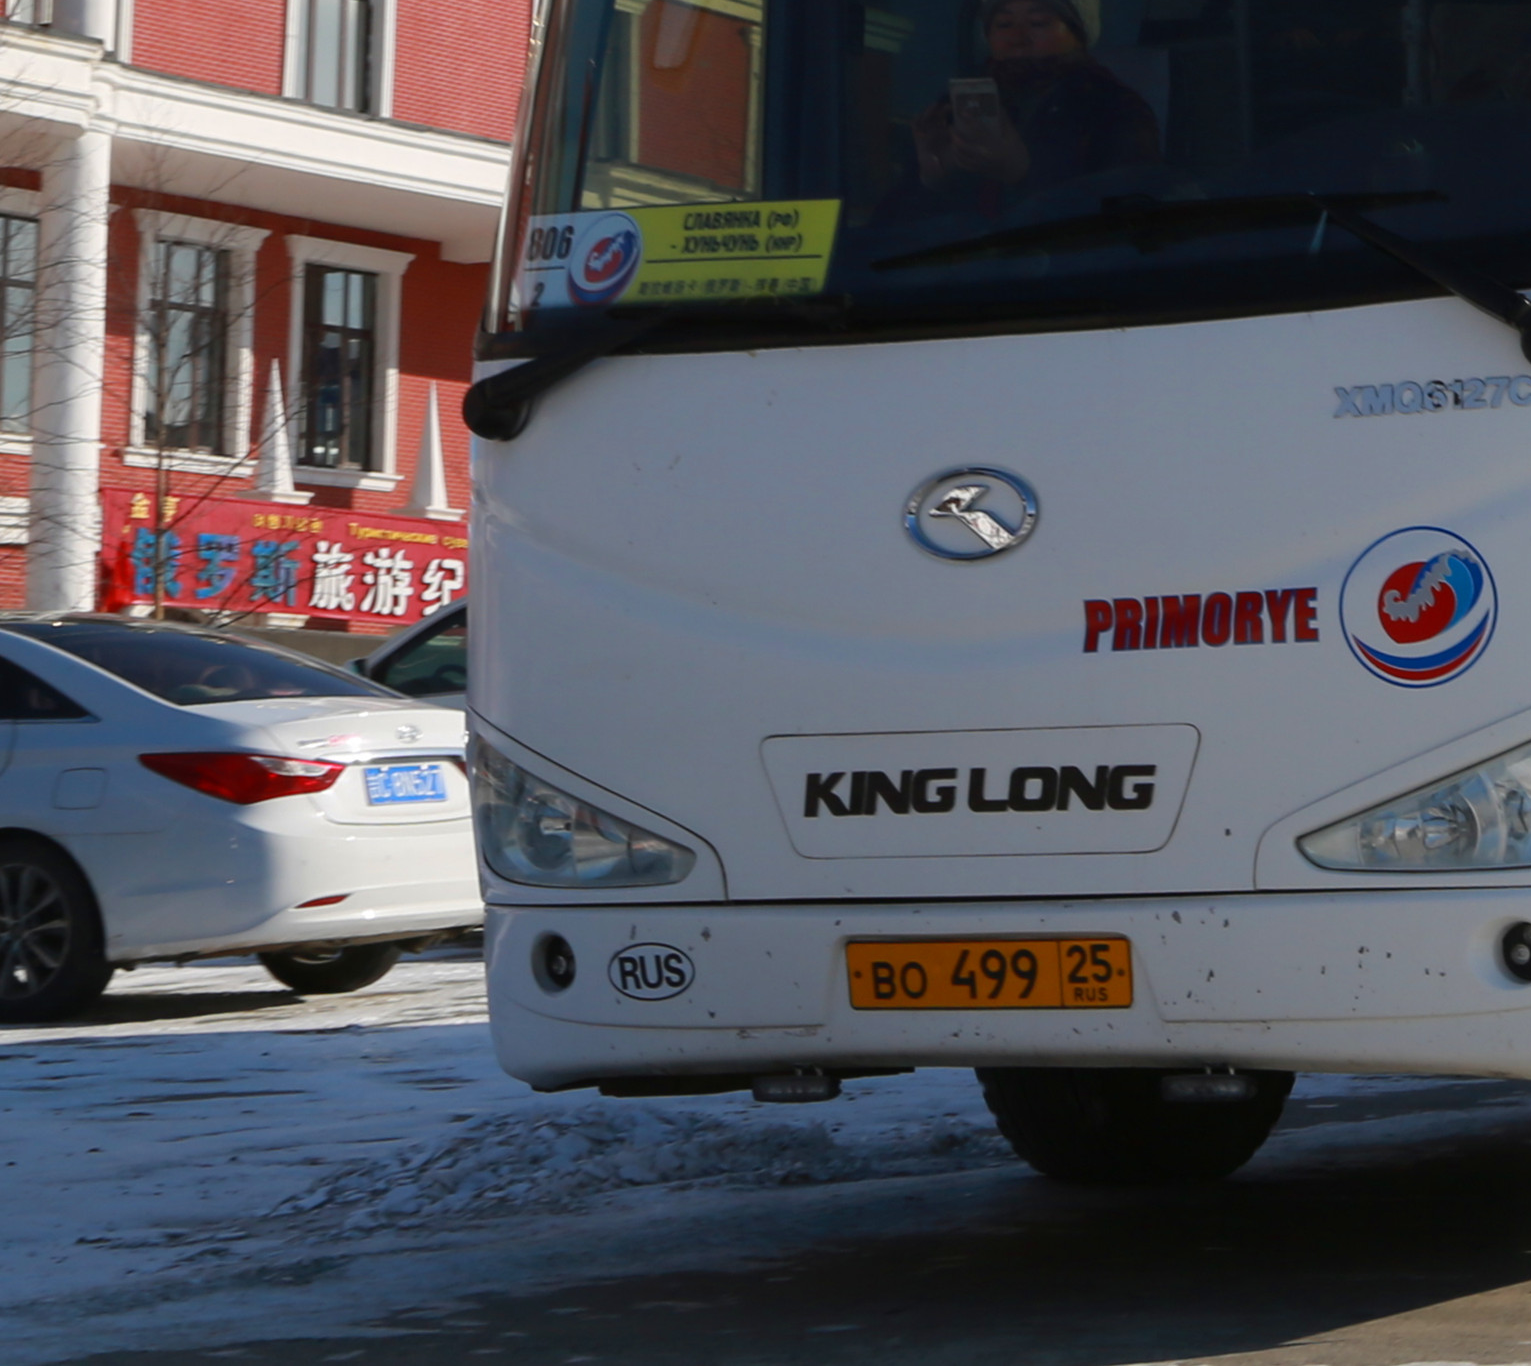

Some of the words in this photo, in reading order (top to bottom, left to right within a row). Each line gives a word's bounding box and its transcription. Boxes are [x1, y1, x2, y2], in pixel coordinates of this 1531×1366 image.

[683, 211, 761, 231] СЛАВЯНКА
[767, 208, 800, 230] (РФ)
[681, 235, 760, 254] ХУНЬЧУНЬ
[1082, 586, 1319, 653] PRIMORYE
[803, 767, 957, 818] KING
[967, 764, 1157, 813] LONG
[618, 953, 686, 990] RUS
[872, 961, 927, 1000] ВО
[950, 948, 1039, 1000] 499
[1066, 943, 1112, 984] 25
[1073, 986, 1109, 1004] RUS
